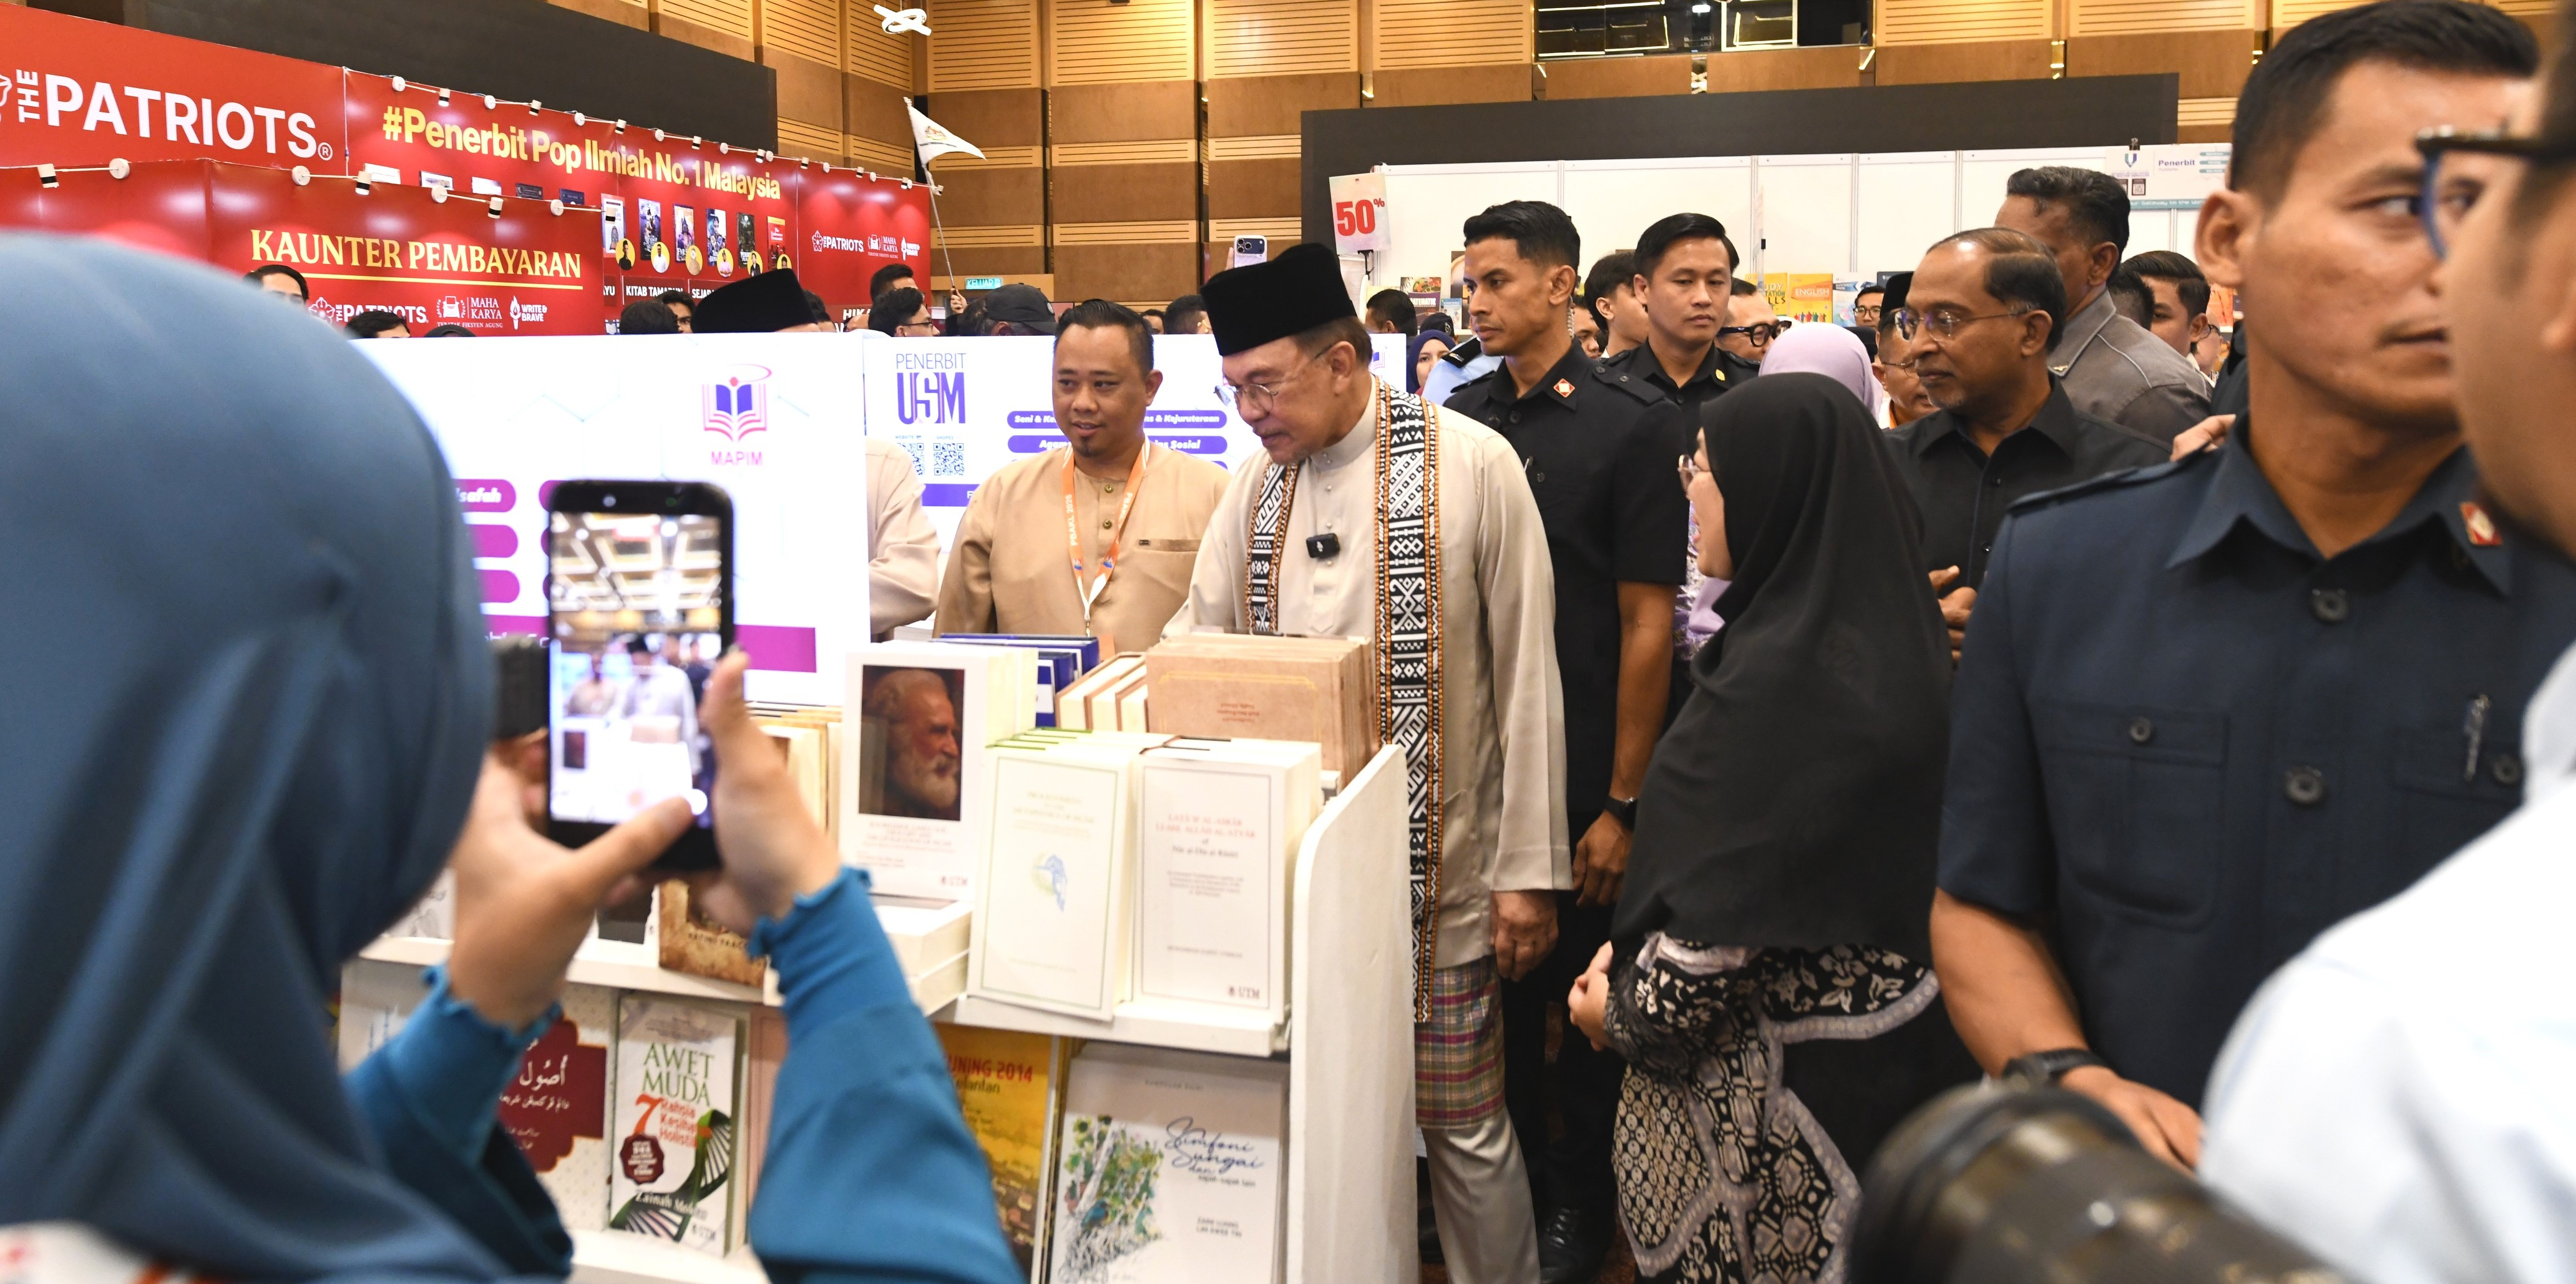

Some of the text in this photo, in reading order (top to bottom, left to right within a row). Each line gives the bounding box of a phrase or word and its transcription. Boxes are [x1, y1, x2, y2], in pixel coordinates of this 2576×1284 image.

[17, 69, 40, 122] THE
[383, 106, 781, 200] #Penerbit Pop Ilmiah No. 1 Malaysia
[1336, 198, 1385, 236] 50%
[250, 229, 581, 278] KAUNTER PEMBAYARAN
[827, 236, 864, 252] PATRIOTS
[626, 286, 647, 296] KITAB
[1795, 288, 1830, 296] ENGLISH
[471, 296, 502, 320] MAHA KARYA
[521, 312, 544, 322] BRAVE
[895, 353, 967, 370] PENERBIT
[897, 372, 966, 424] USM
[1014, 415, 1034, 423] Seni
[1164, 414, 1220, 424] Kejuruteraan
[1170, 439, 1201, 449] Sosial
[711, 451, 763, 466] MAPIM
[1067, 514, 1078, 546] PBAKL
[643, 1042, 716, 1079] AWET
[997, 1060, 1033, 1083] 2014
[642, 1069, 710, 1106] MUDA
[635, 1093, 665, 1137] 7
